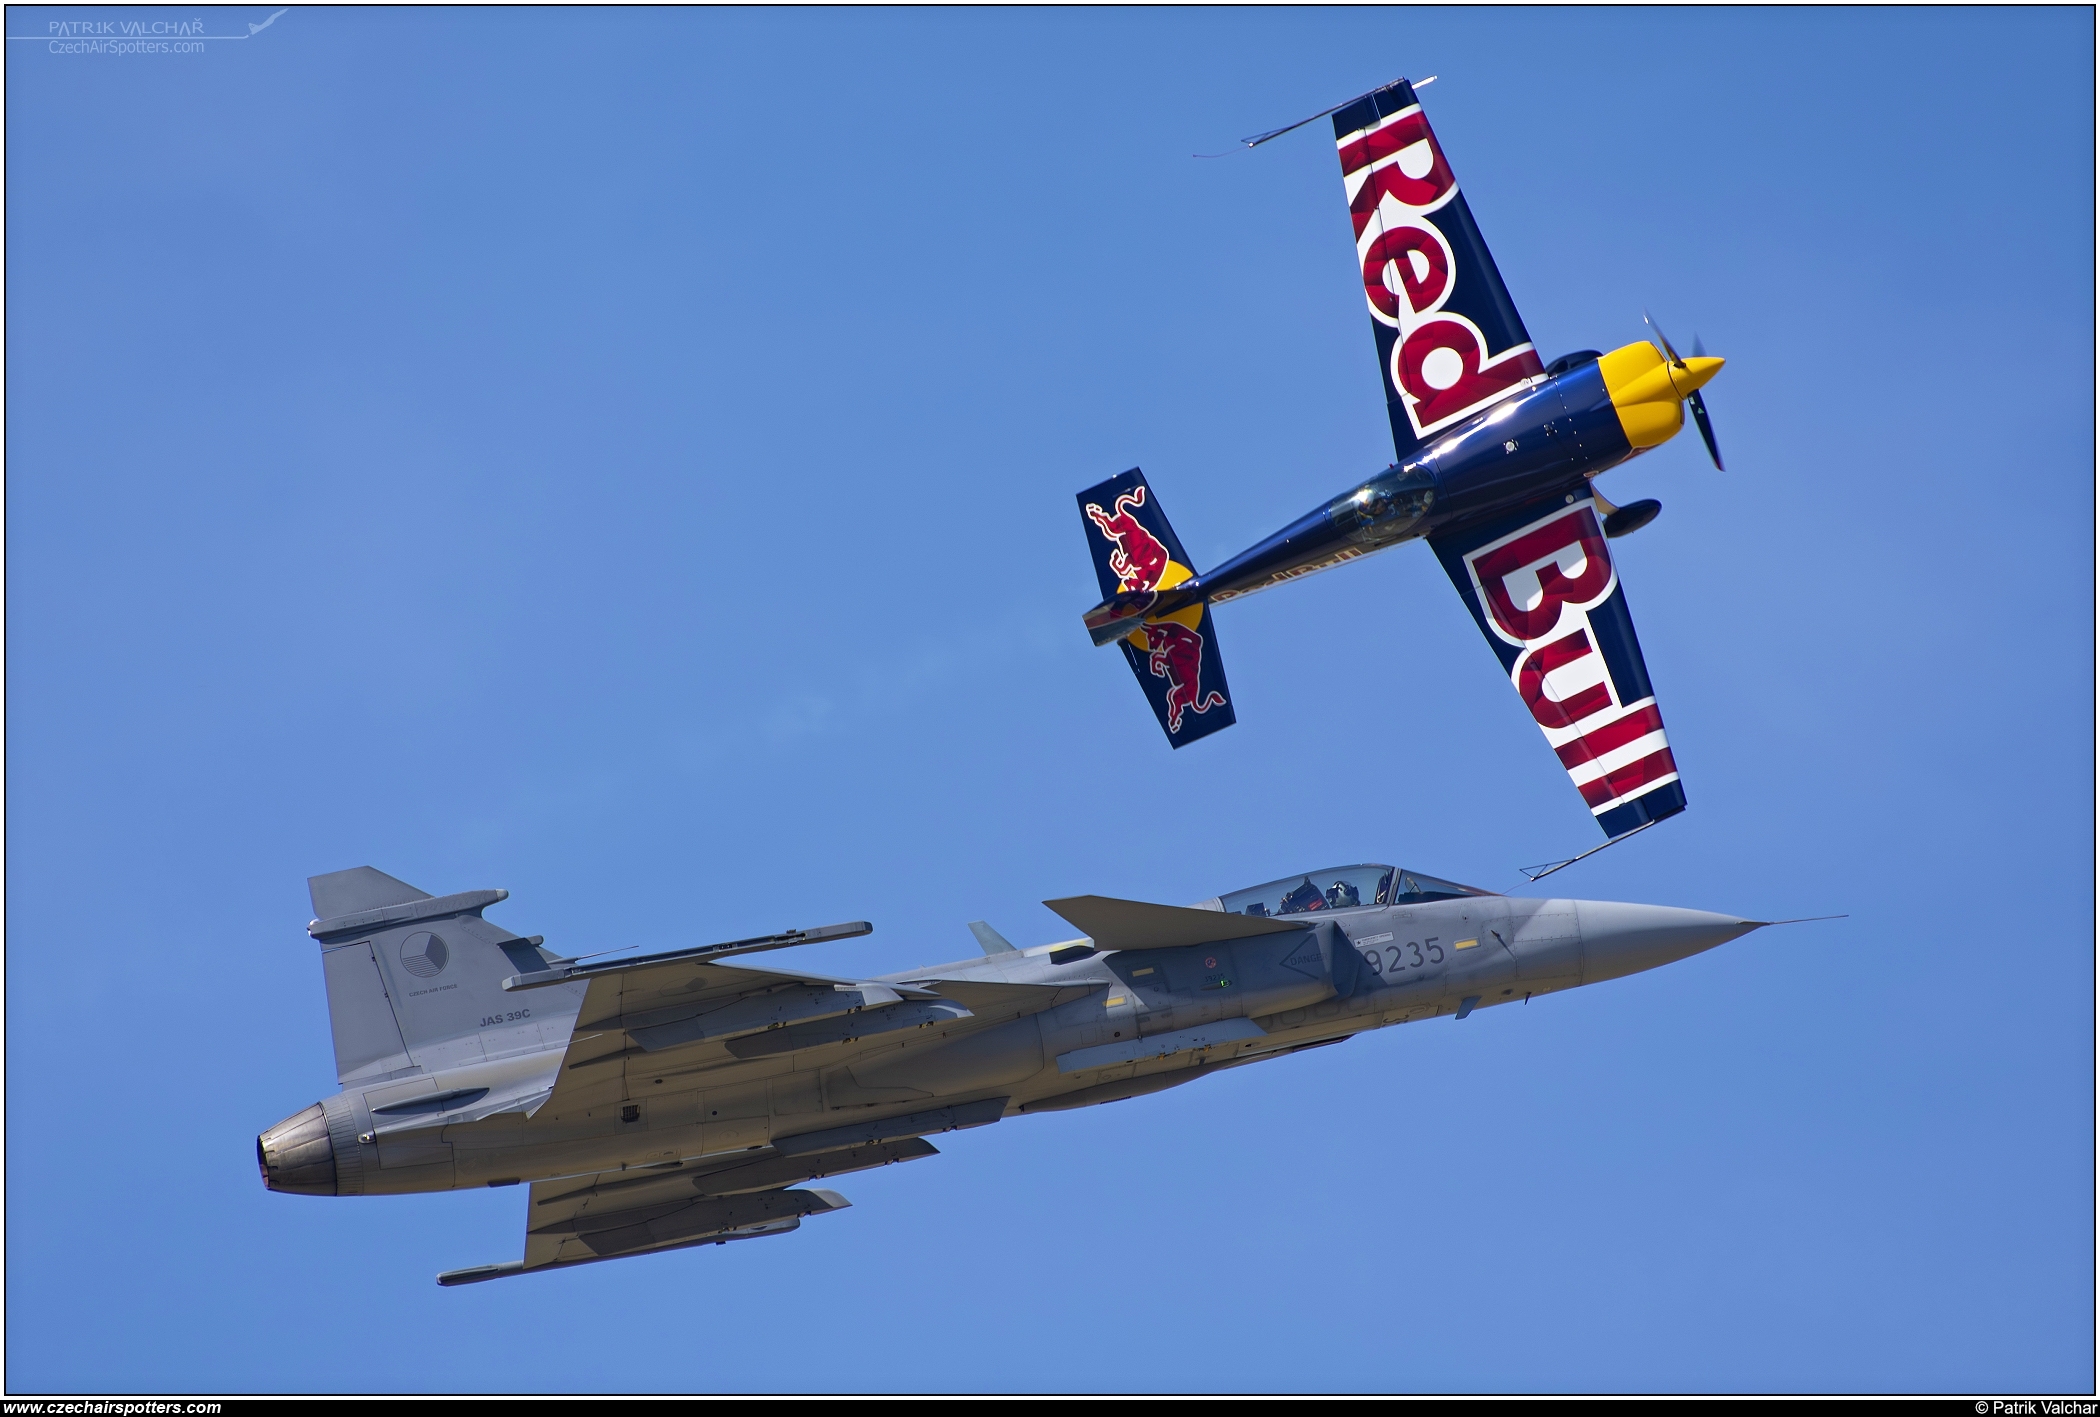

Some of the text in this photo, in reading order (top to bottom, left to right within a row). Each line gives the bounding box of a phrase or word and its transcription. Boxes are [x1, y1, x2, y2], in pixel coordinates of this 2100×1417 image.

[1337, 103, 1679, 815] Red Bull
[1364, 937, 1445, 976] 9235
[408, 989, 428, 997] CZECH
[439, 983, 458, 991] FORCE
[480, 1009, 531, 1027] JAS 39C
